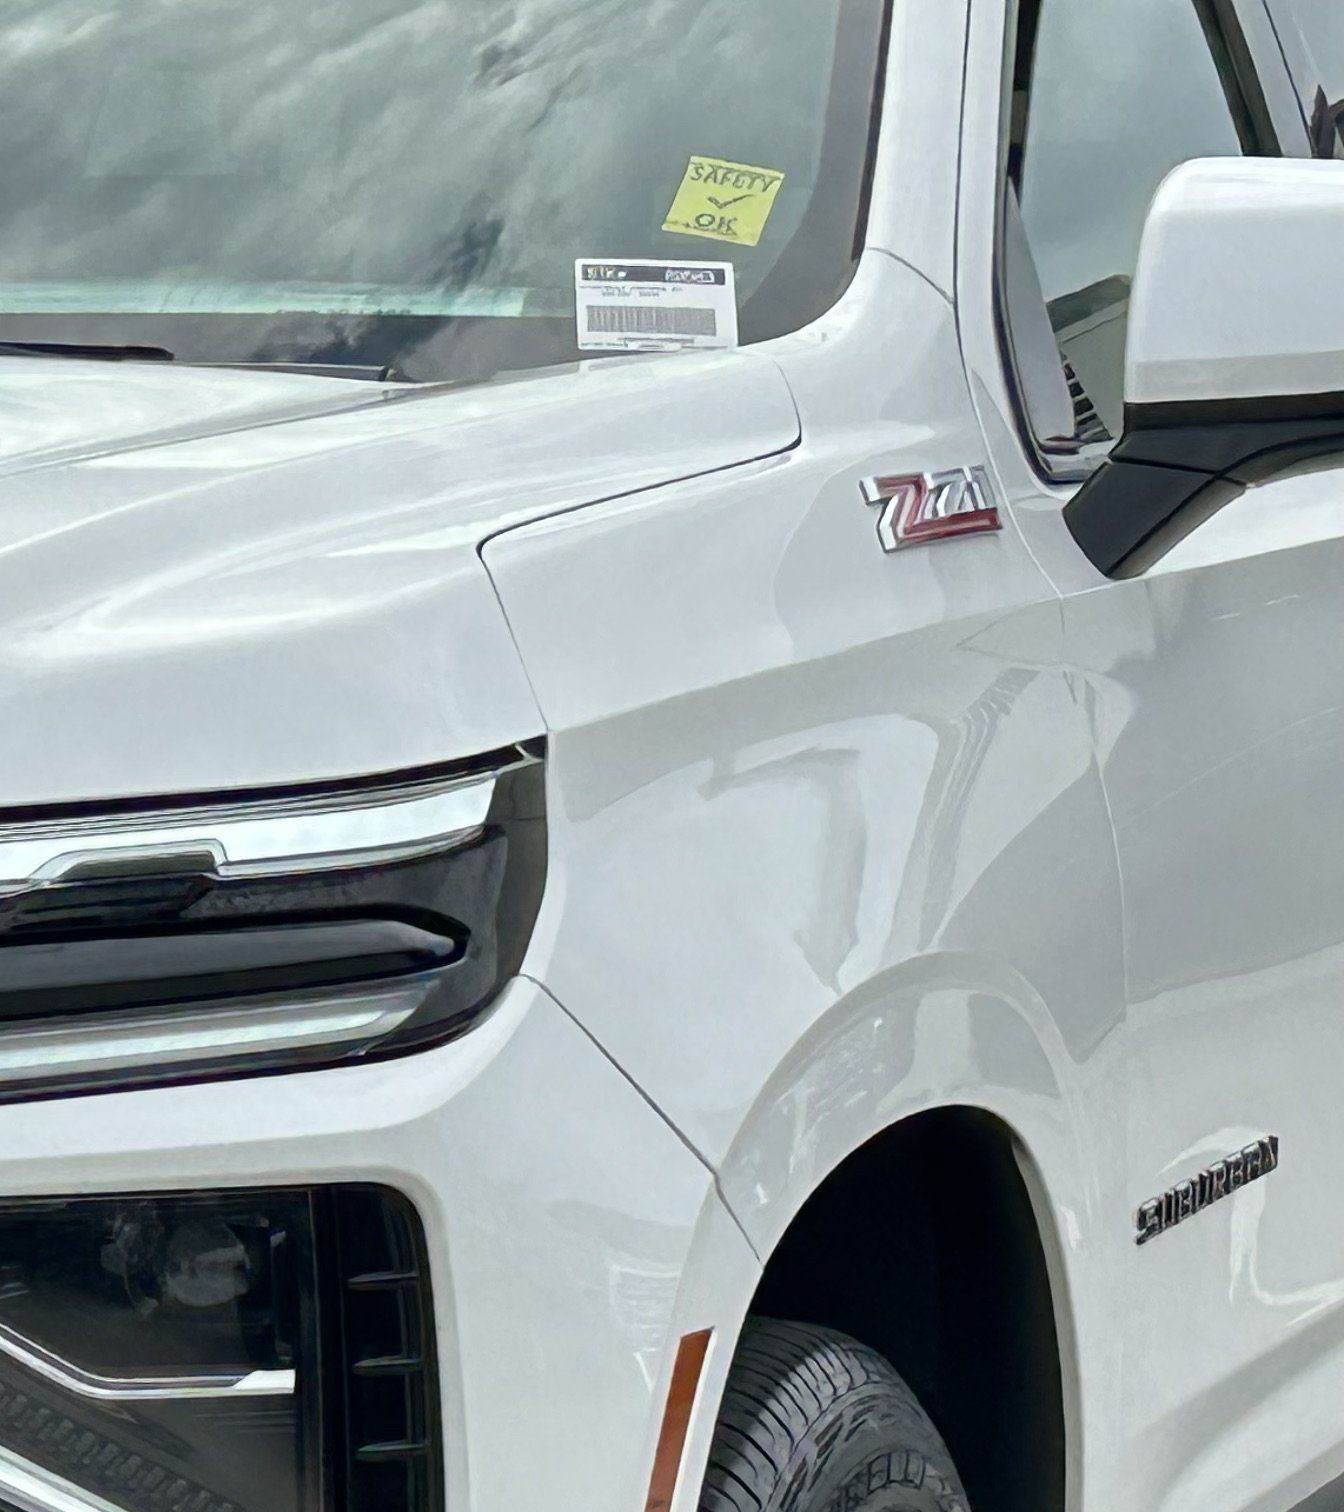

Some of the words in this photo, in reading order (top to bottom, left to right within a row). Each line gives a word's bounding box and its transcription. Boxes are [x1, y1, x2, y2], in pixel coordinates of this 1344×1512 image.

[689, 163, 781, 192] SAFETY
[695, 212, 739, 236] OK
[859, 465, 1003, 553] Z71
